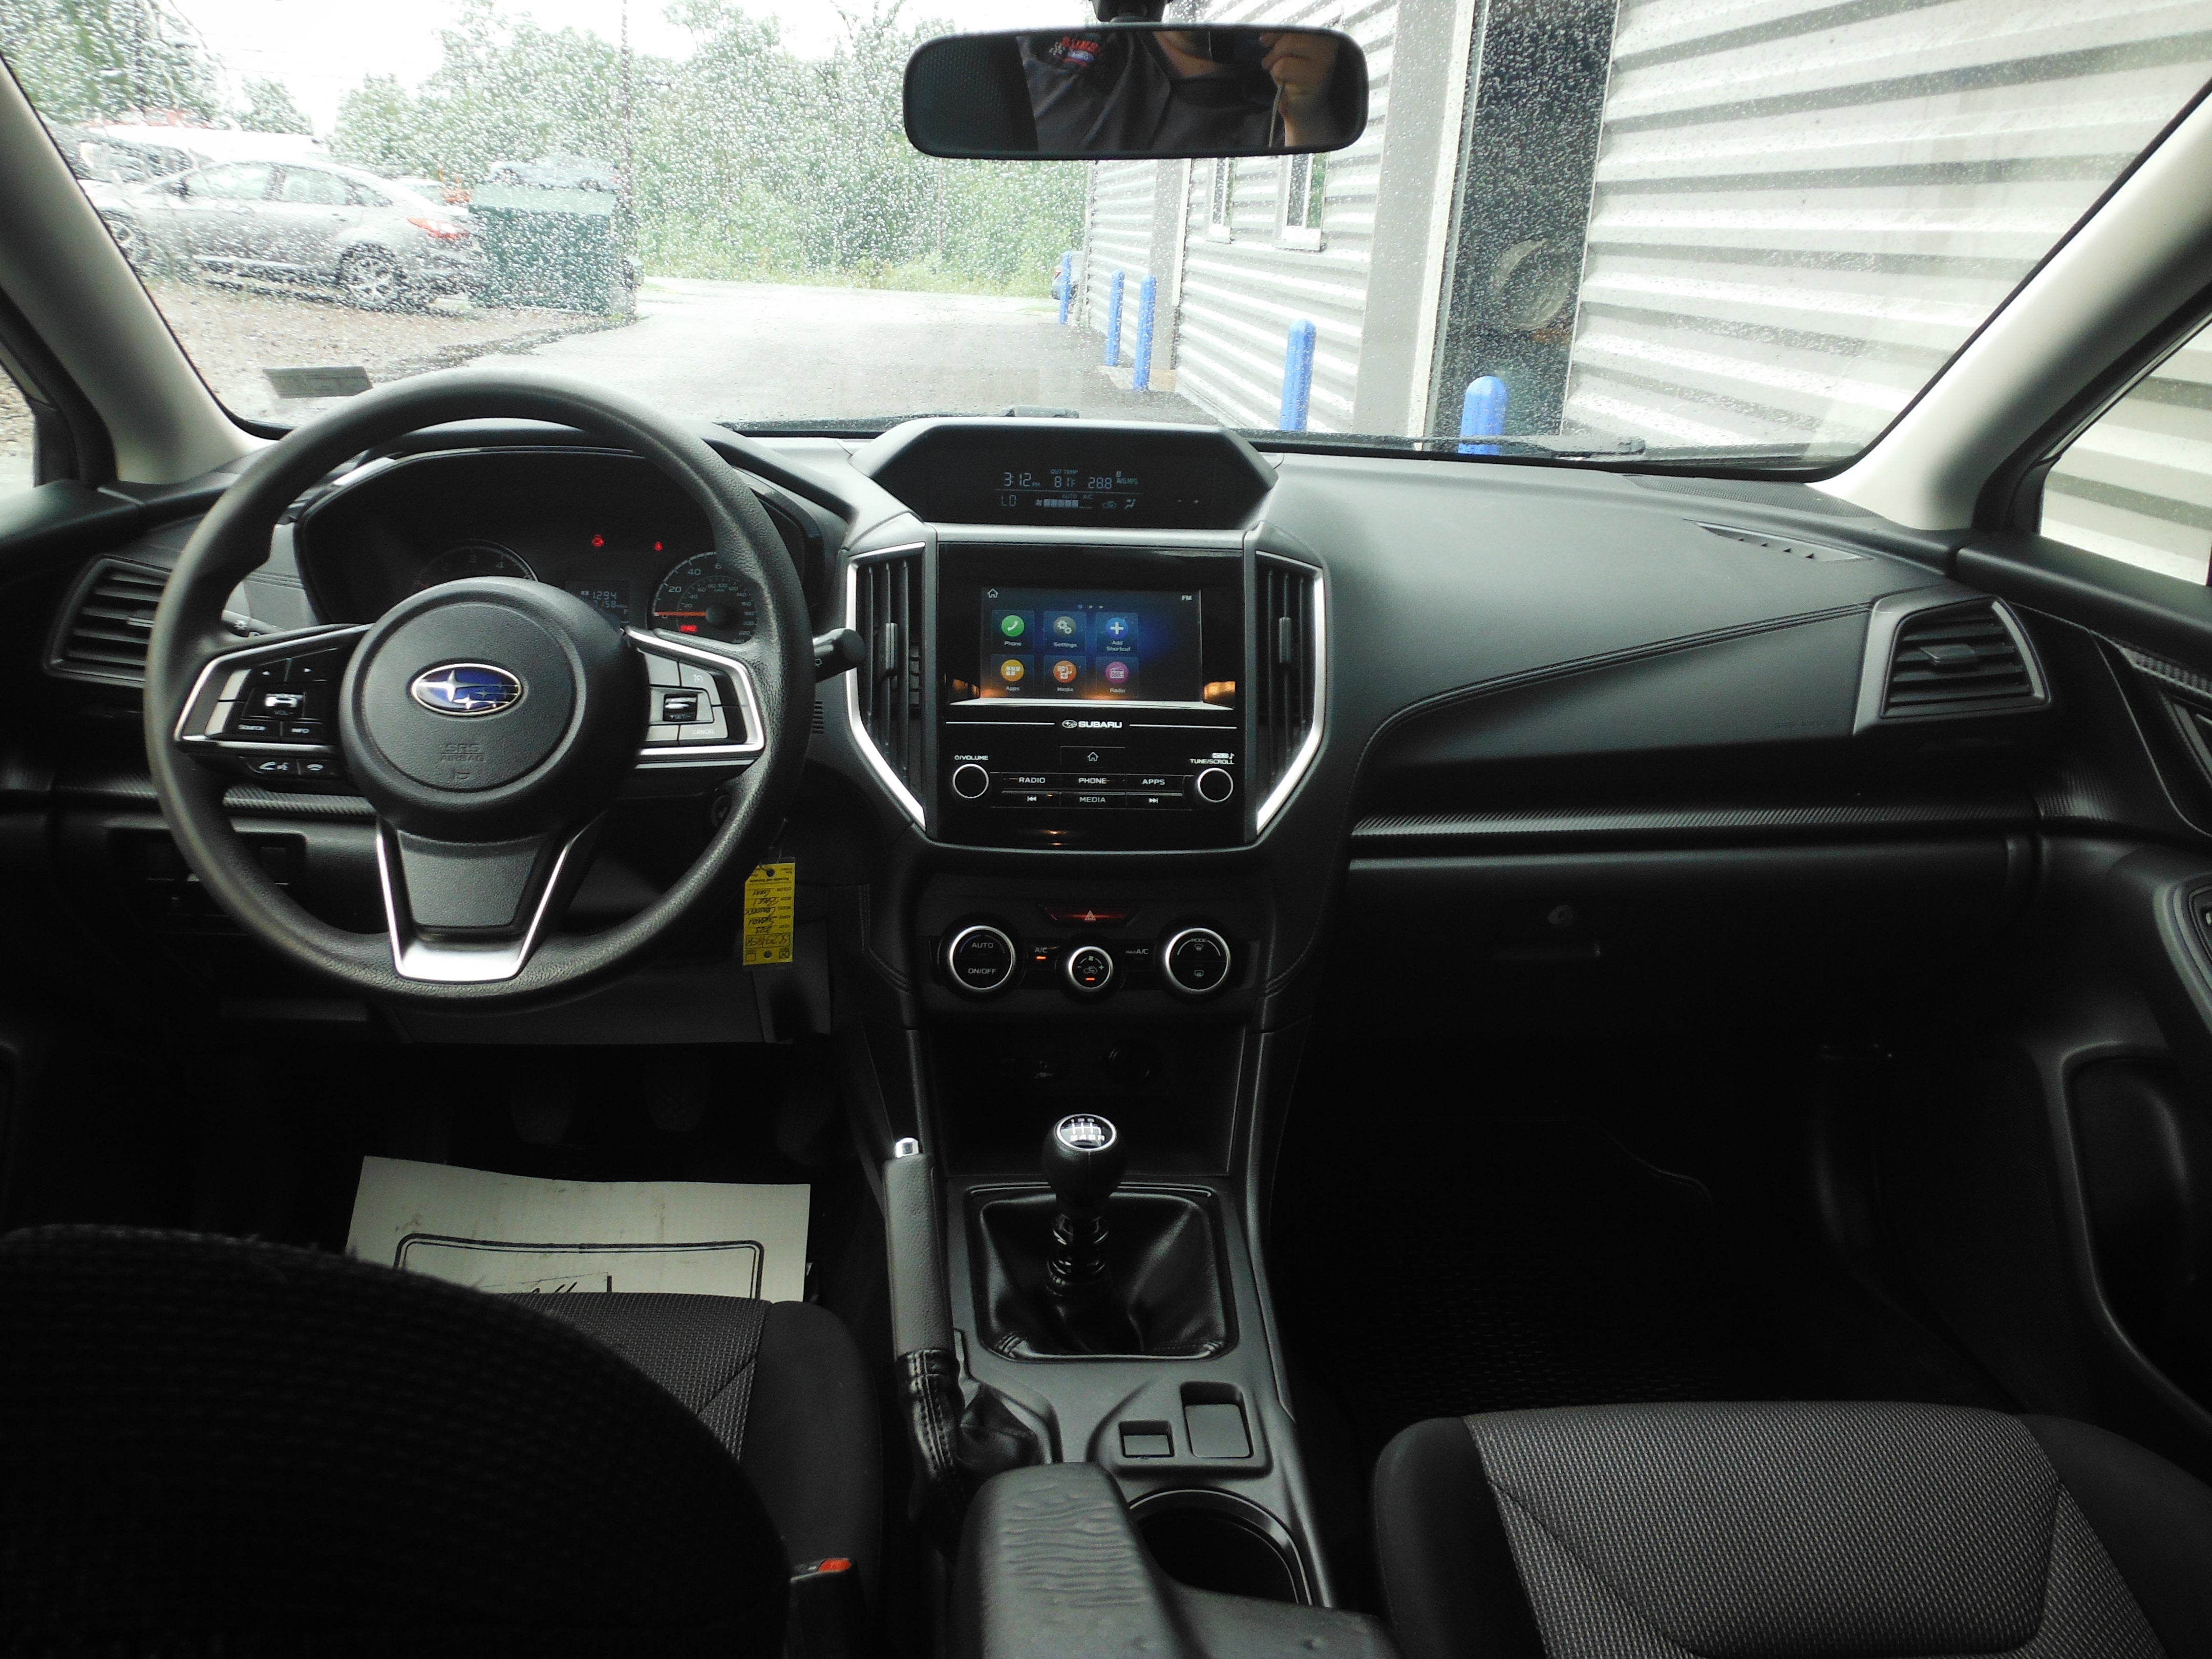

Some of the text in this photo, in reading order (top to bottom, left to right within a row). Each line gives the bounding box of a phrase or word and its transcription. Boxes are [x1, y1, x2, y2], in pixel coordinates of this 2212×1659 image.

[1004, 472, 1032, 487] 3:12
[1078, 720, 1122, 729] SUBARU
[446, 743, 481, 753] SRS
